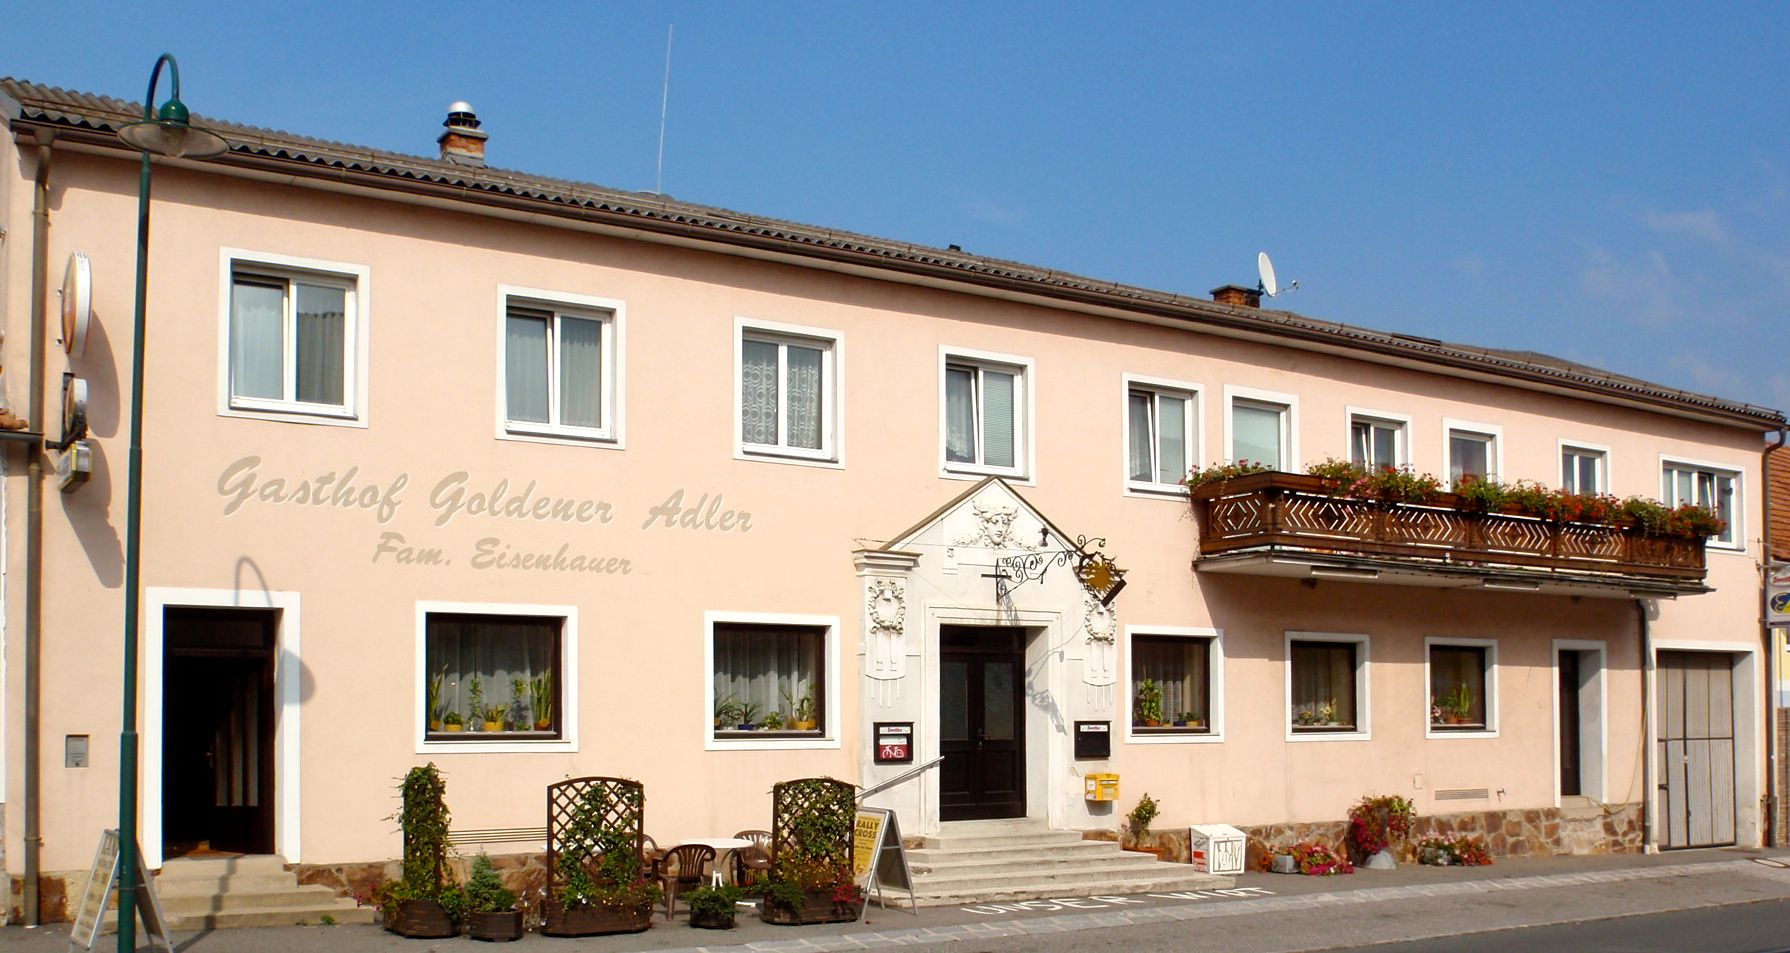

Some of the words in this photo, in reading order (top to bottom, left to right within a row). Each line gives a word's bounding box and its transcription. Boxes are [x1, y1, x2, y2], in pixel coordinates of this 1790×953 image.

[217, 455, 408, 524] Gasthof
[429, 471, 613, 527] Goldener
[641, 488, 753, 533] Adler
[372, 531, 452, 565] Fam.
[470, 537, 632, 575] Eisenhauer
[854, 829, 876, 838] CROSS
[856, 820, 879, 830] RALLY
[960, 895, 1145, 915] UNSER
[1147, 887, 1276, 900] WIRT
